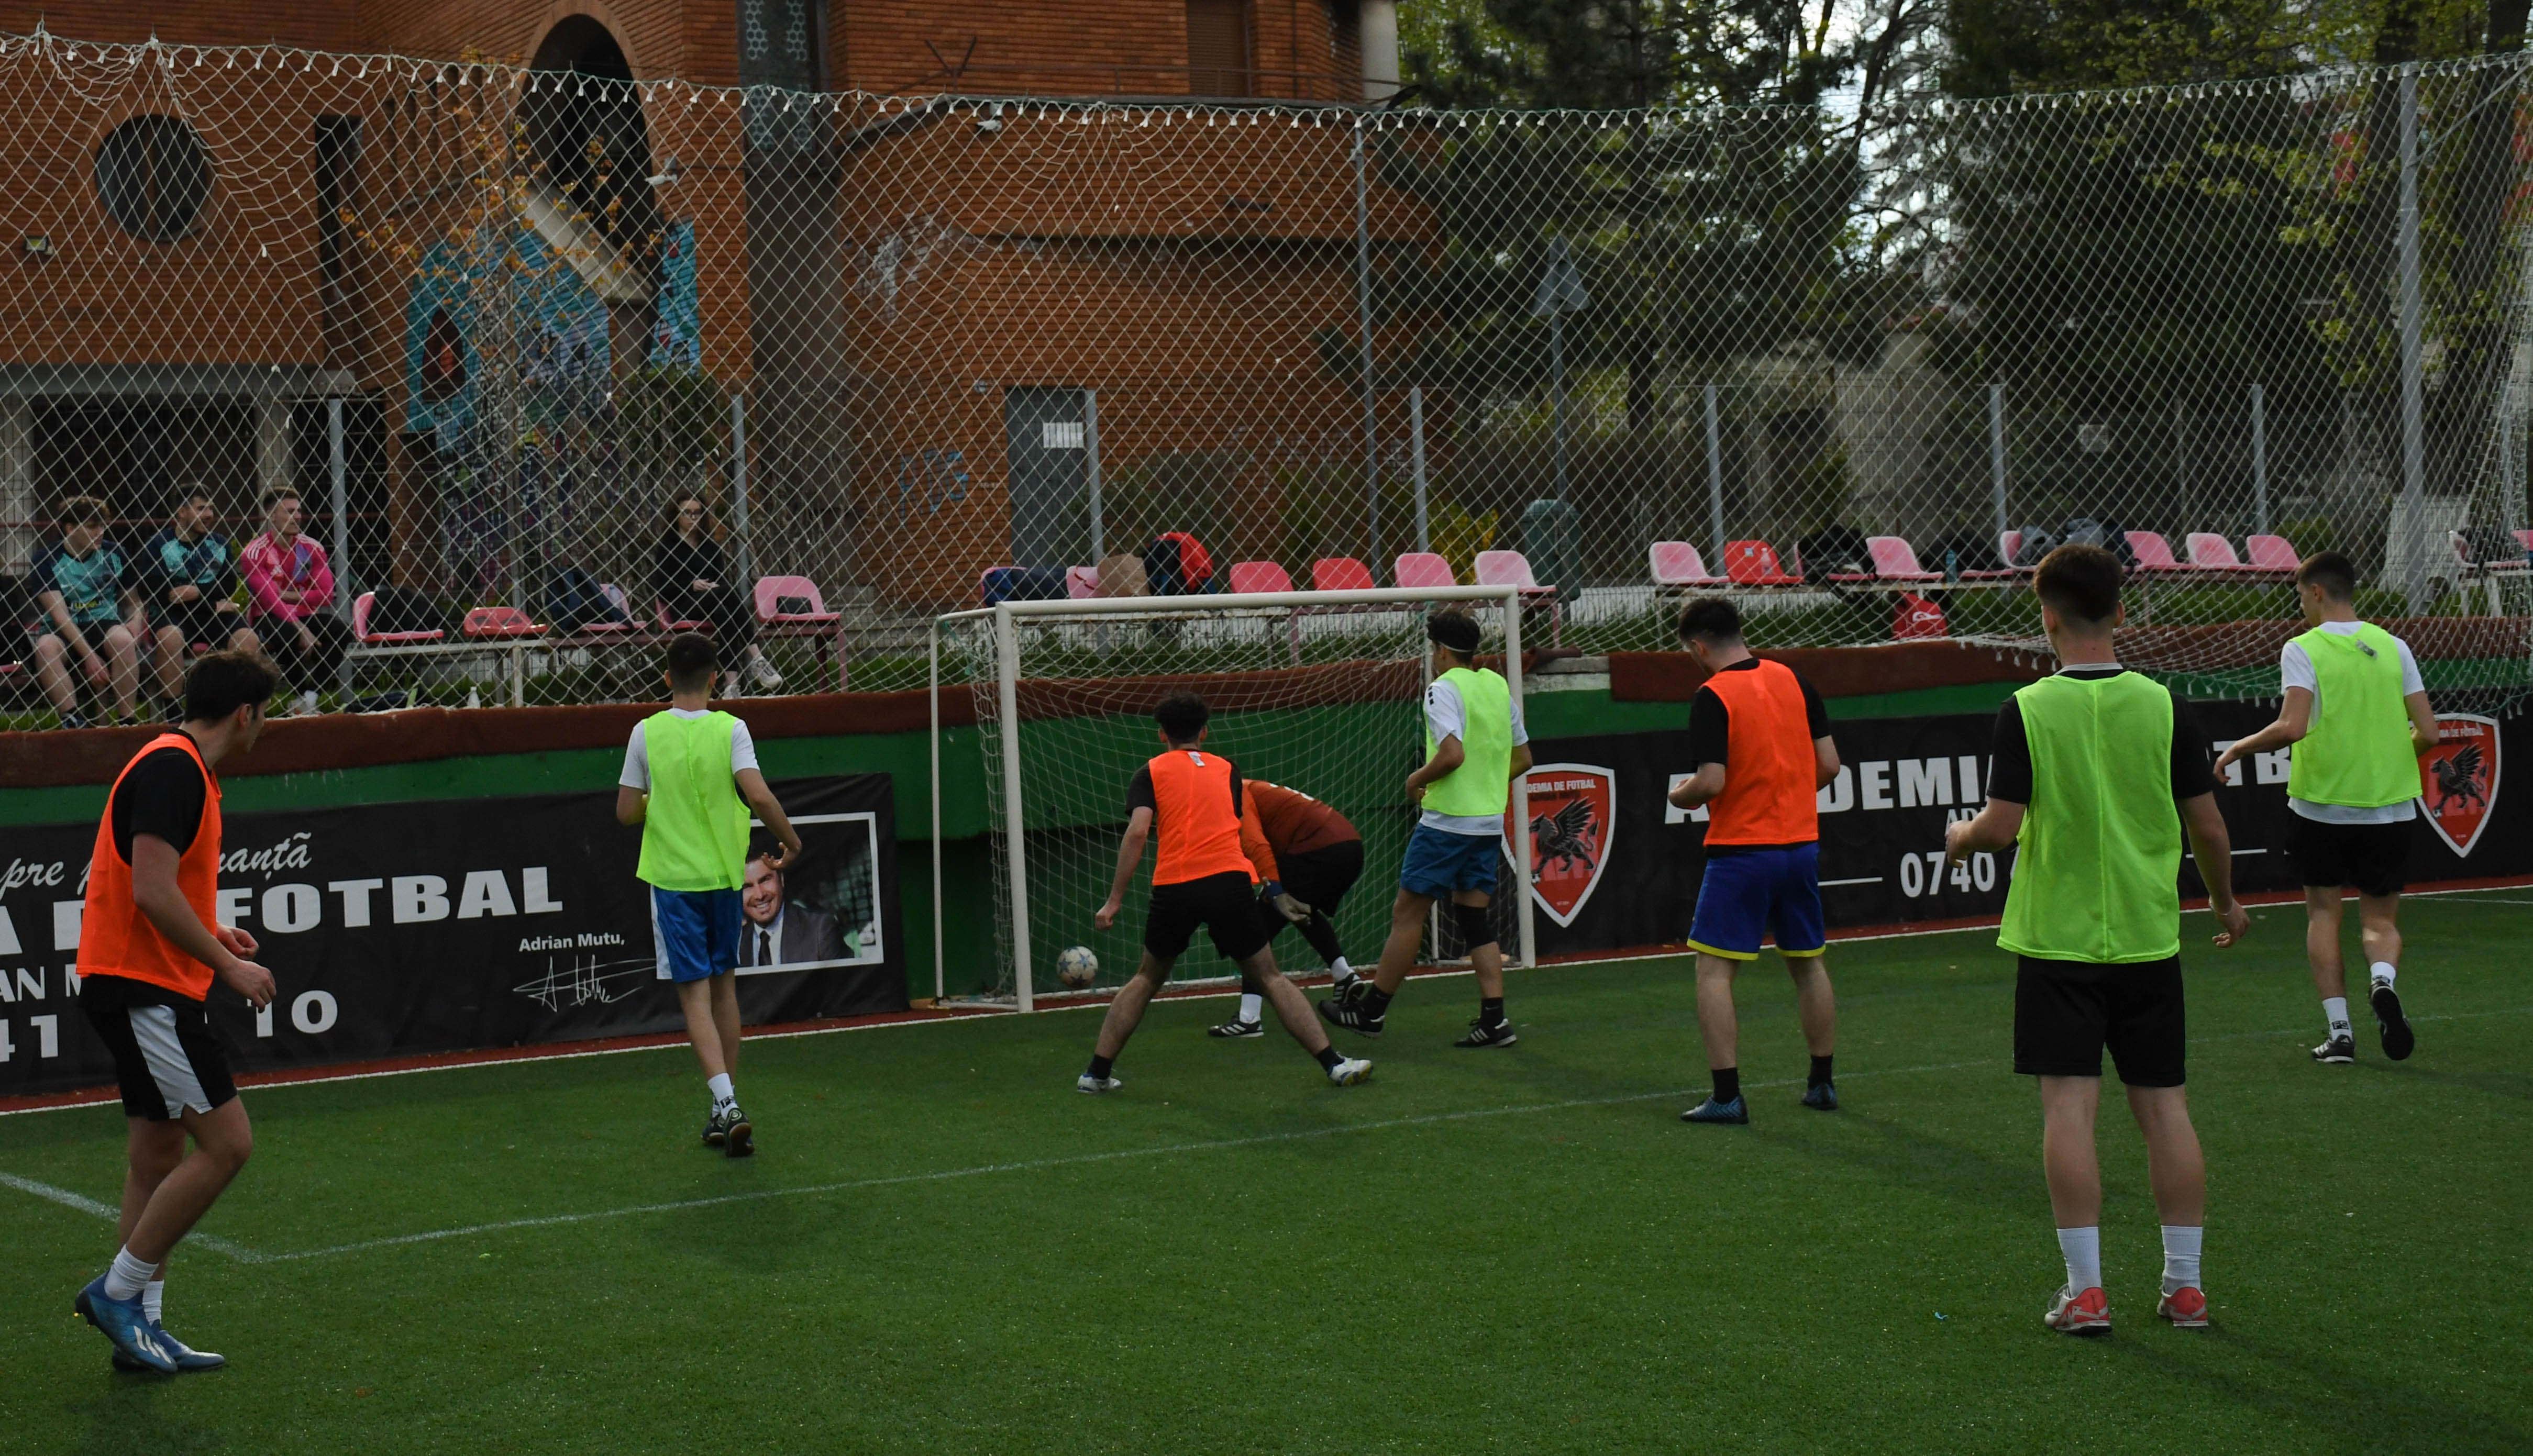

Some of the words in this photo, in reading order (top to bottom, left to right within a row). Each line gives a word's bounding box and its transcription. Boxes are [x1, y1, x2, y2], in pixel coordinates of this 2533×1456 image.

[1527, 782, 1552, 793] DEMIA
[1554, 781, 1565, 791] DE
[1567, 779, 1596, 790] FOTBAL
[1900, 851, 1996, 898] 0740
[519, 935, 573, 952] Adrian
[578, 932, 625, 948] Mutu,
